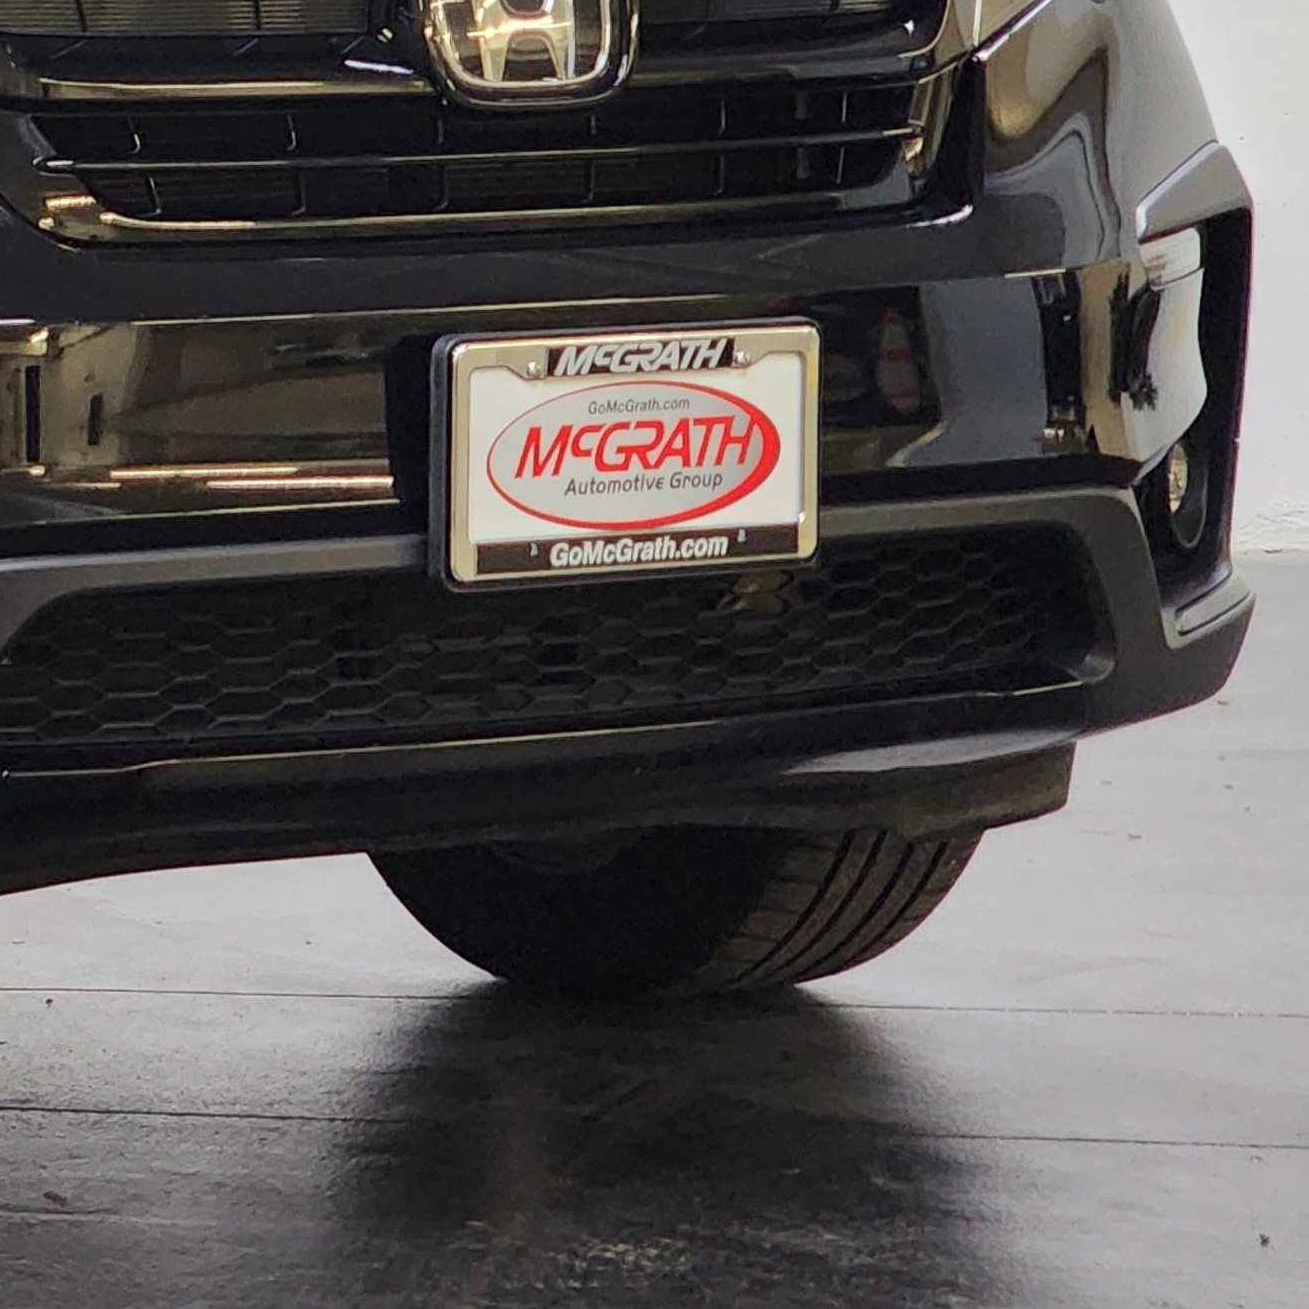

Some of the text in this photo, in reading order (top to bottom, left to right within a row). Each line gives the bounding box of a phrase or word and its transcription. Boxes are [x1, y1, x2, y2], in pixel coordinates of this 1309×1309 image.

[588, 397, 691, 416] GoMcGrath.com
[564, 471, 723, 497] Automotive Group
[550, 535, 729, 568] GoMcGrath.com
